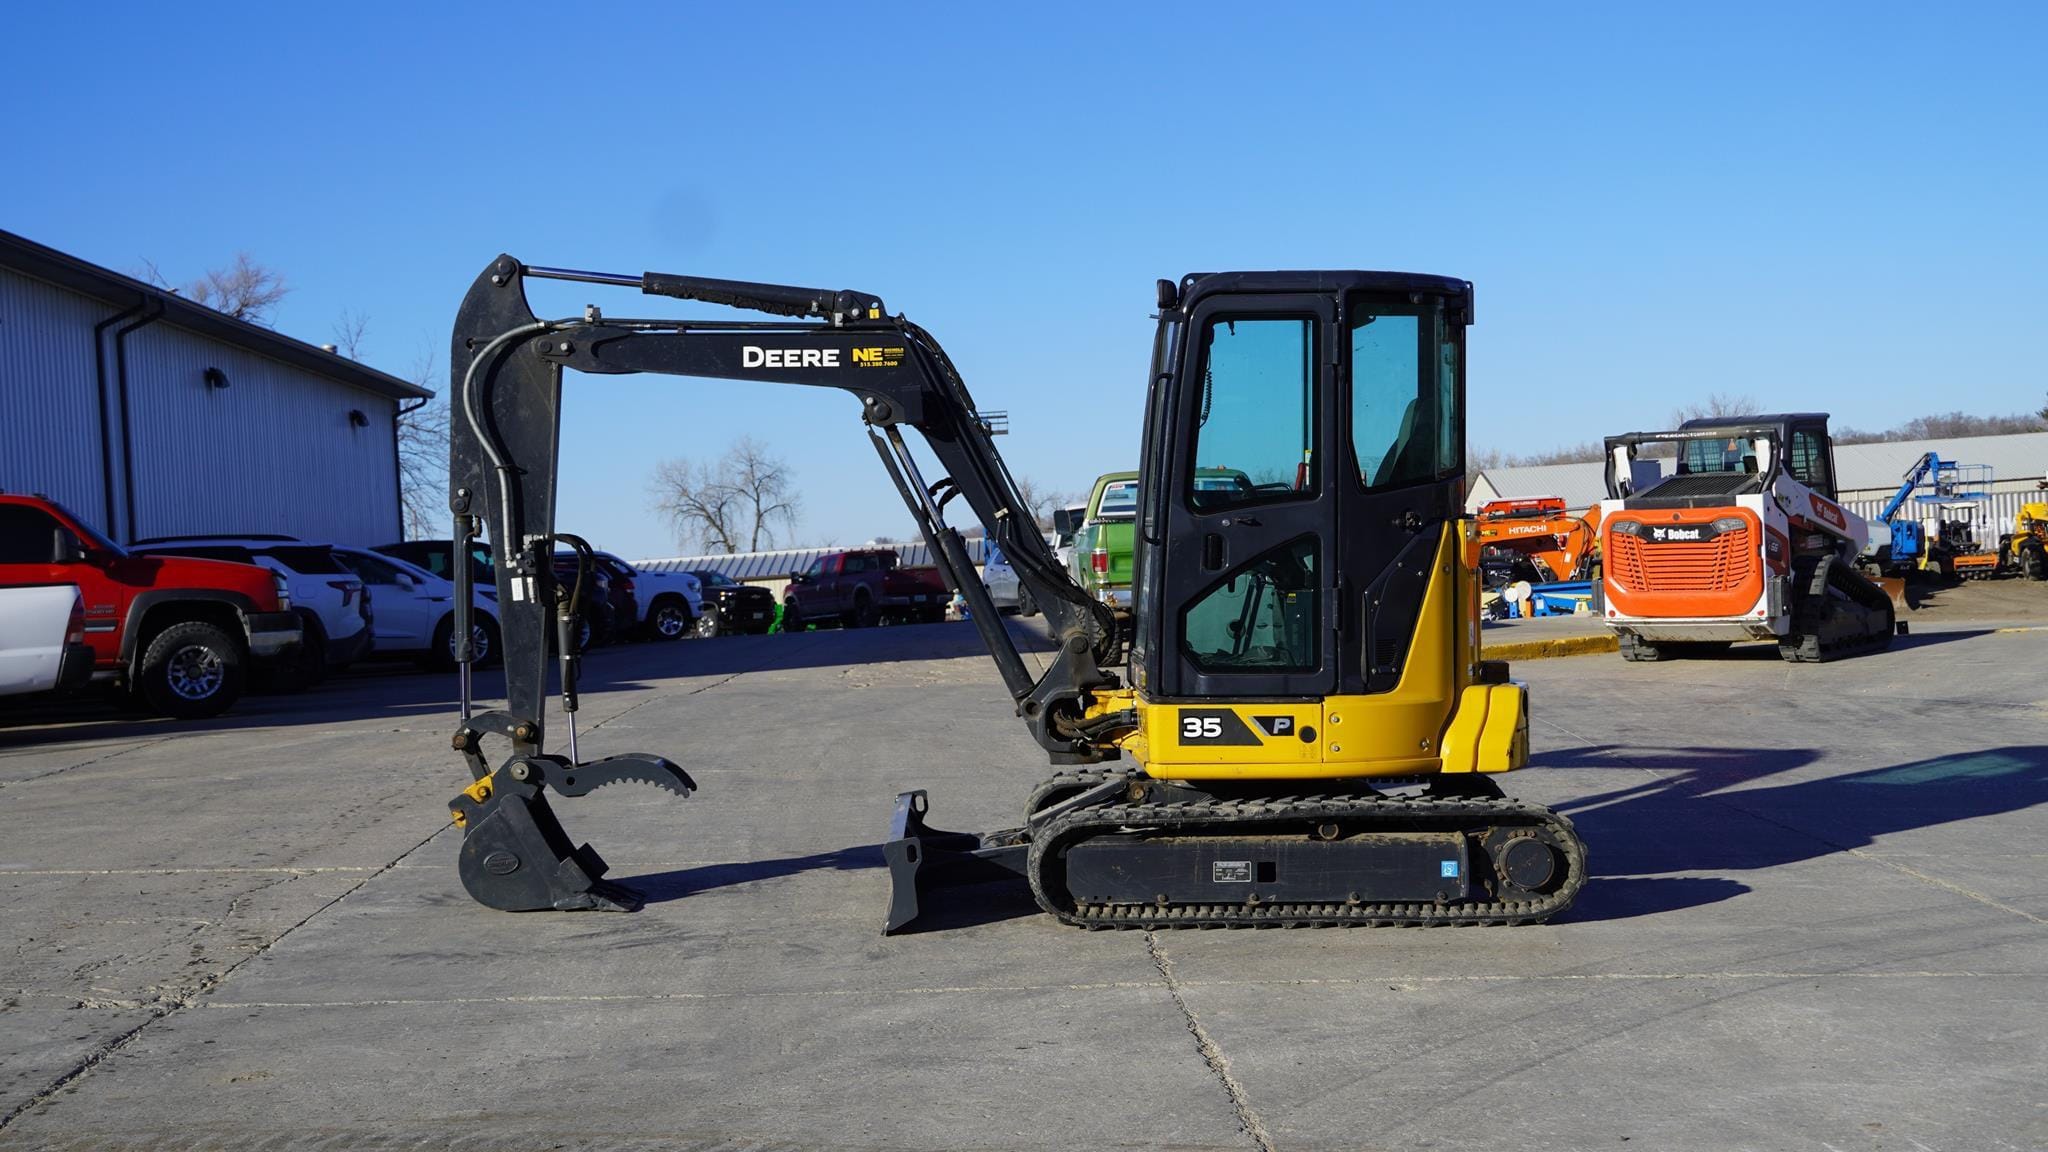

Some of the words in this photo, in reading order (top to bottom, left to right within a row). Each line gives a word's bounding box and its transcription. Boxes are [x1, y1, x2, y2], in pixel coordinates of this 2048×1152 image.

[743, 346, 840, 368] DEERE
[852, 348, 883, 362] NE
[1508, 525, 1547, 535] HITACHI
[1668, 529, 1699, 539] Bobcat
[1183, 717, 1222, 738] 35
[1273, 718, 1291, 734] P
